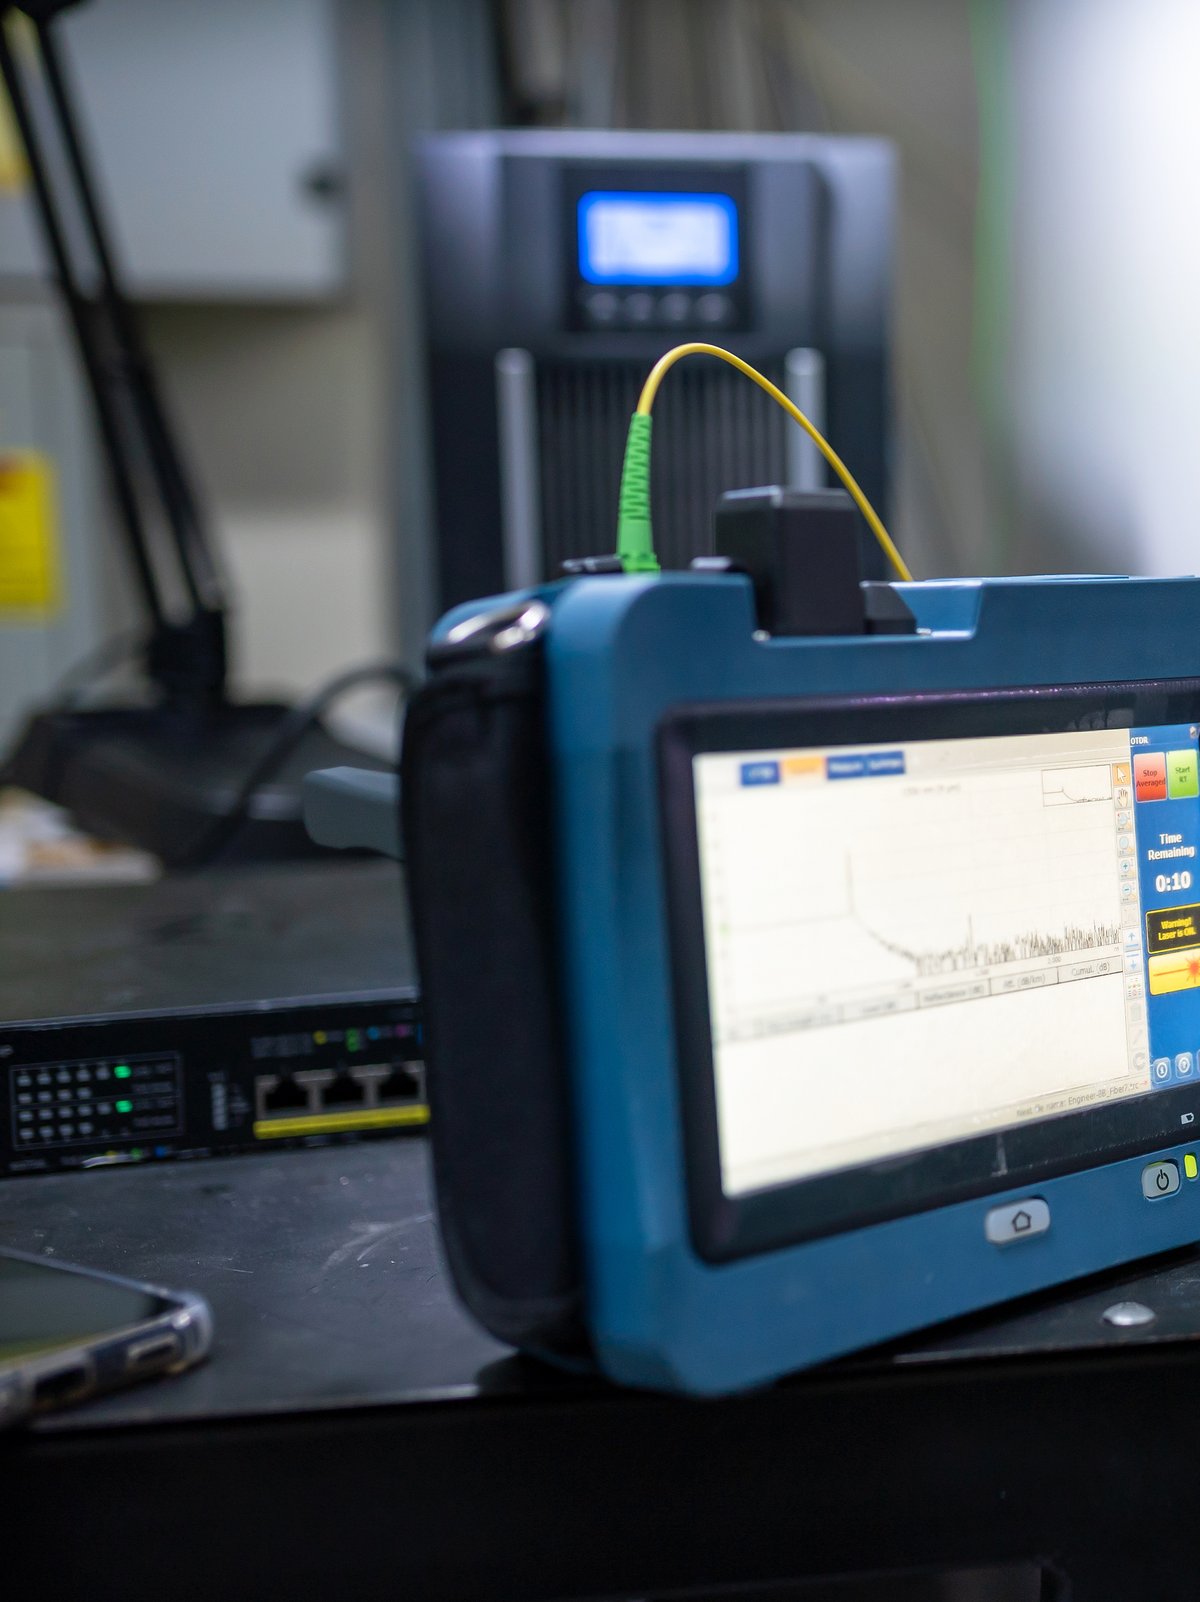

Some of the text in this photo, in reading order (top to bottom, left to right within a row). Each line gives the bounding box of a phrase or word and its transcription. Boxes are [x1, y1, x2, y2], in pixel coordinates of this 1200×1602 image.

[1130, 736, 1149, 745] OTDR
[1143, 769, 1158, 777] Stop
[1160, 833, 1182, 845] Time
[1148, 846, 1195, 861] Remaining
[1155, 871, 1191, 892] 0:10
[1161, 917, 1192, 929] Warning!
[1158, 931, 1176, 941] Laser
[1177, 929, 1183, 937] is
[1097, 962, 1110, 975] (dB)
